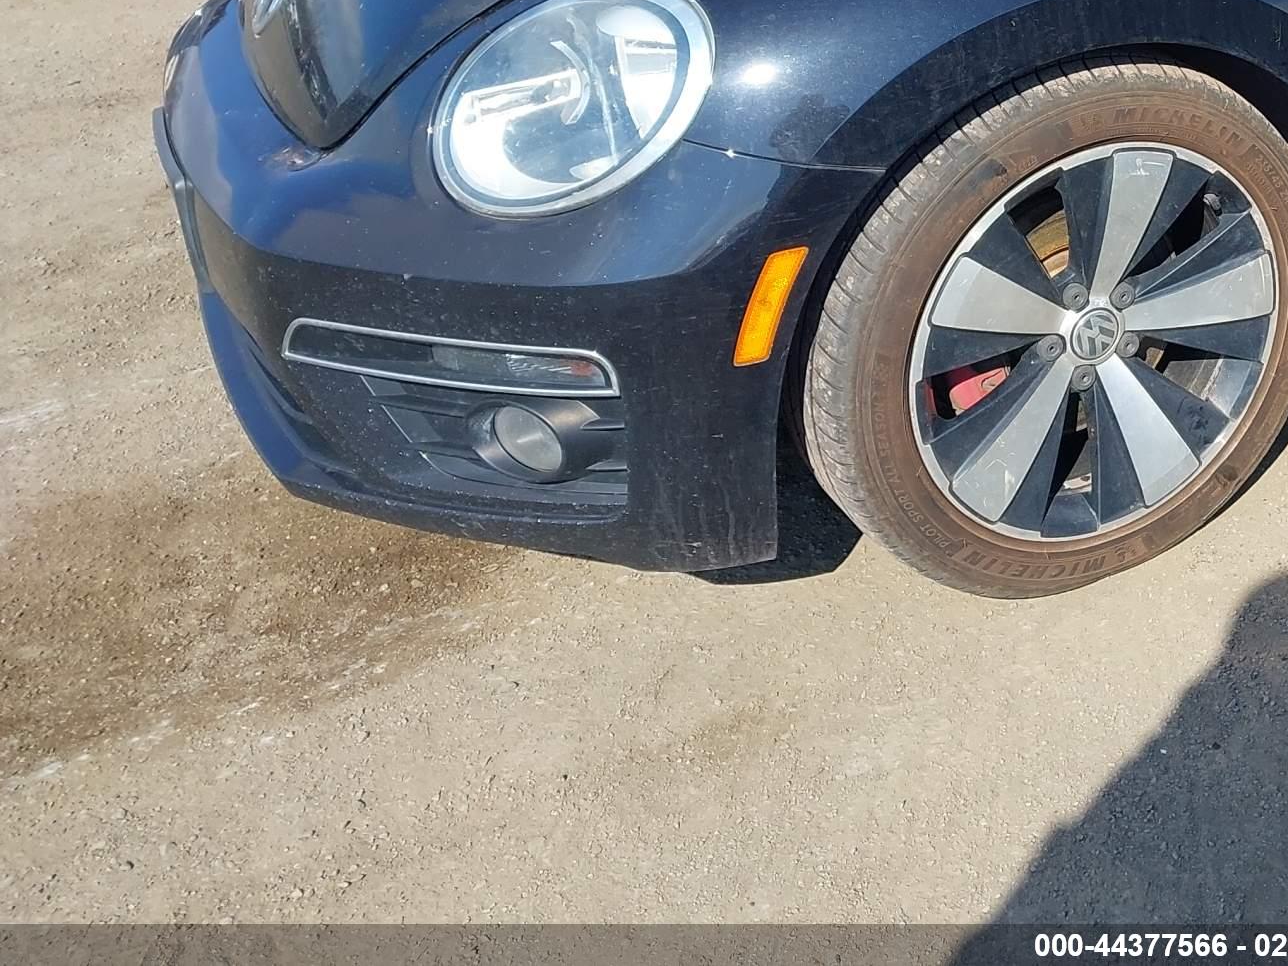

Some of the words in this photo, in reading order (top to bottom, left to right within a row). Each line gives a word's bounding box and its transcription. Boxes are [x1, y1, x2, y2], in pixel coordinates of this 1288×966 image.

[1113, 105, 1244, 147] MICHELIN
[894, 488, 925, 524] SPORT
[919, 523, 951, 549] PILOT
[963, 550, 1106, 580] MICHELIN
